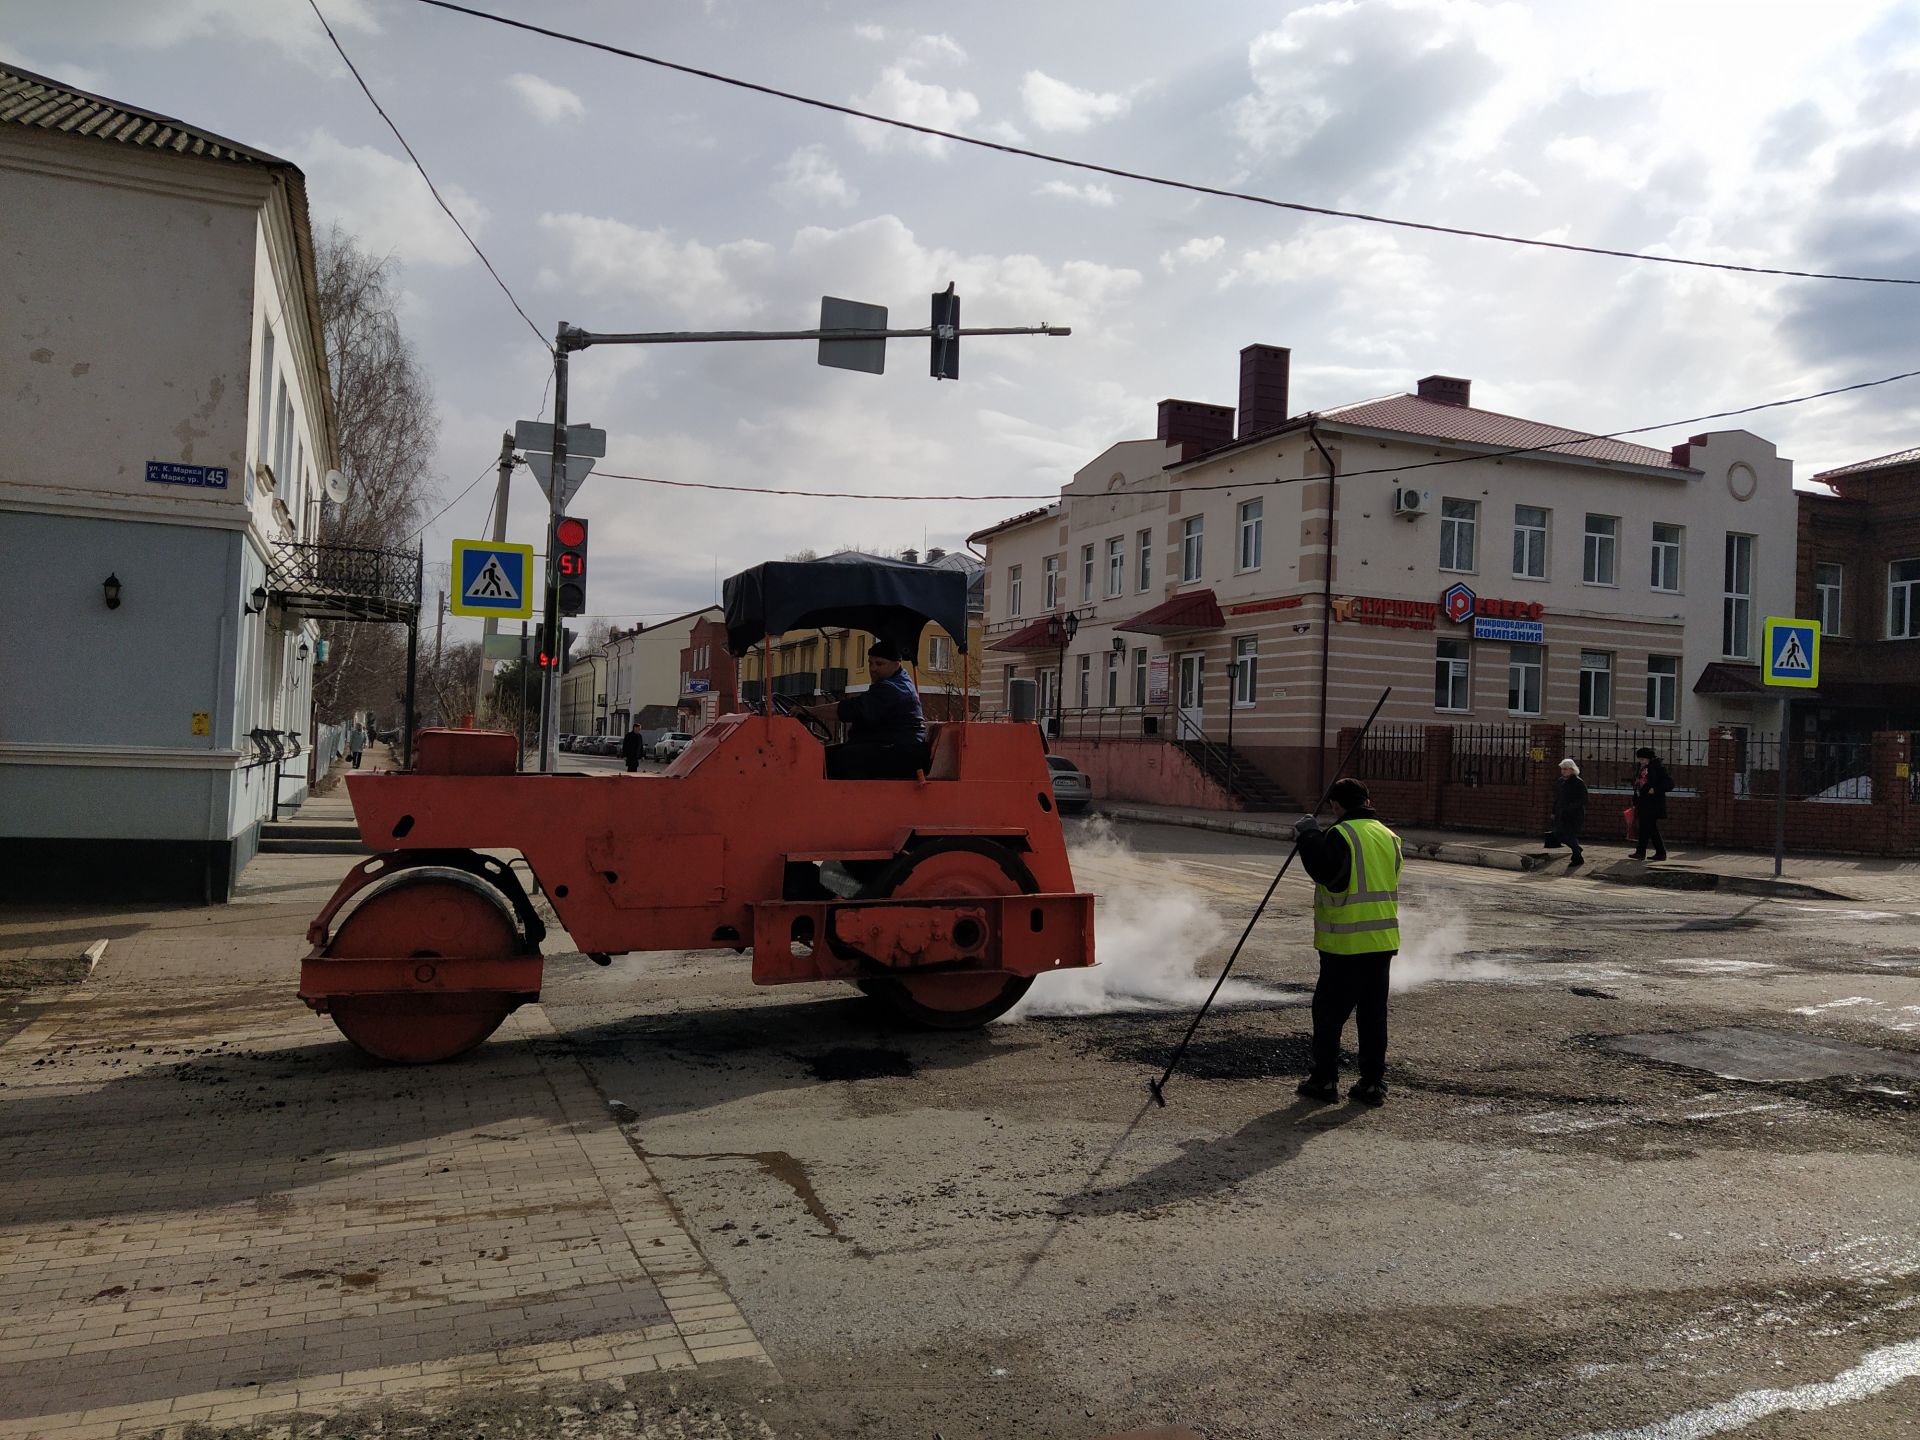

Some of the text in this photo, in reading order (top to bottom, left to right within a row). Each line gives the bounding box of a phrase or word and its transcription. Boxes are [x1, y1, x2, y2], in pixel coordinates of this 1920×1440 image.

[173, 467, 202, 475] Маркса
[161, 474, 186, 482] Маркс
[207, 471, 224, 484] 45
[561, 554, 583, 576] 51
